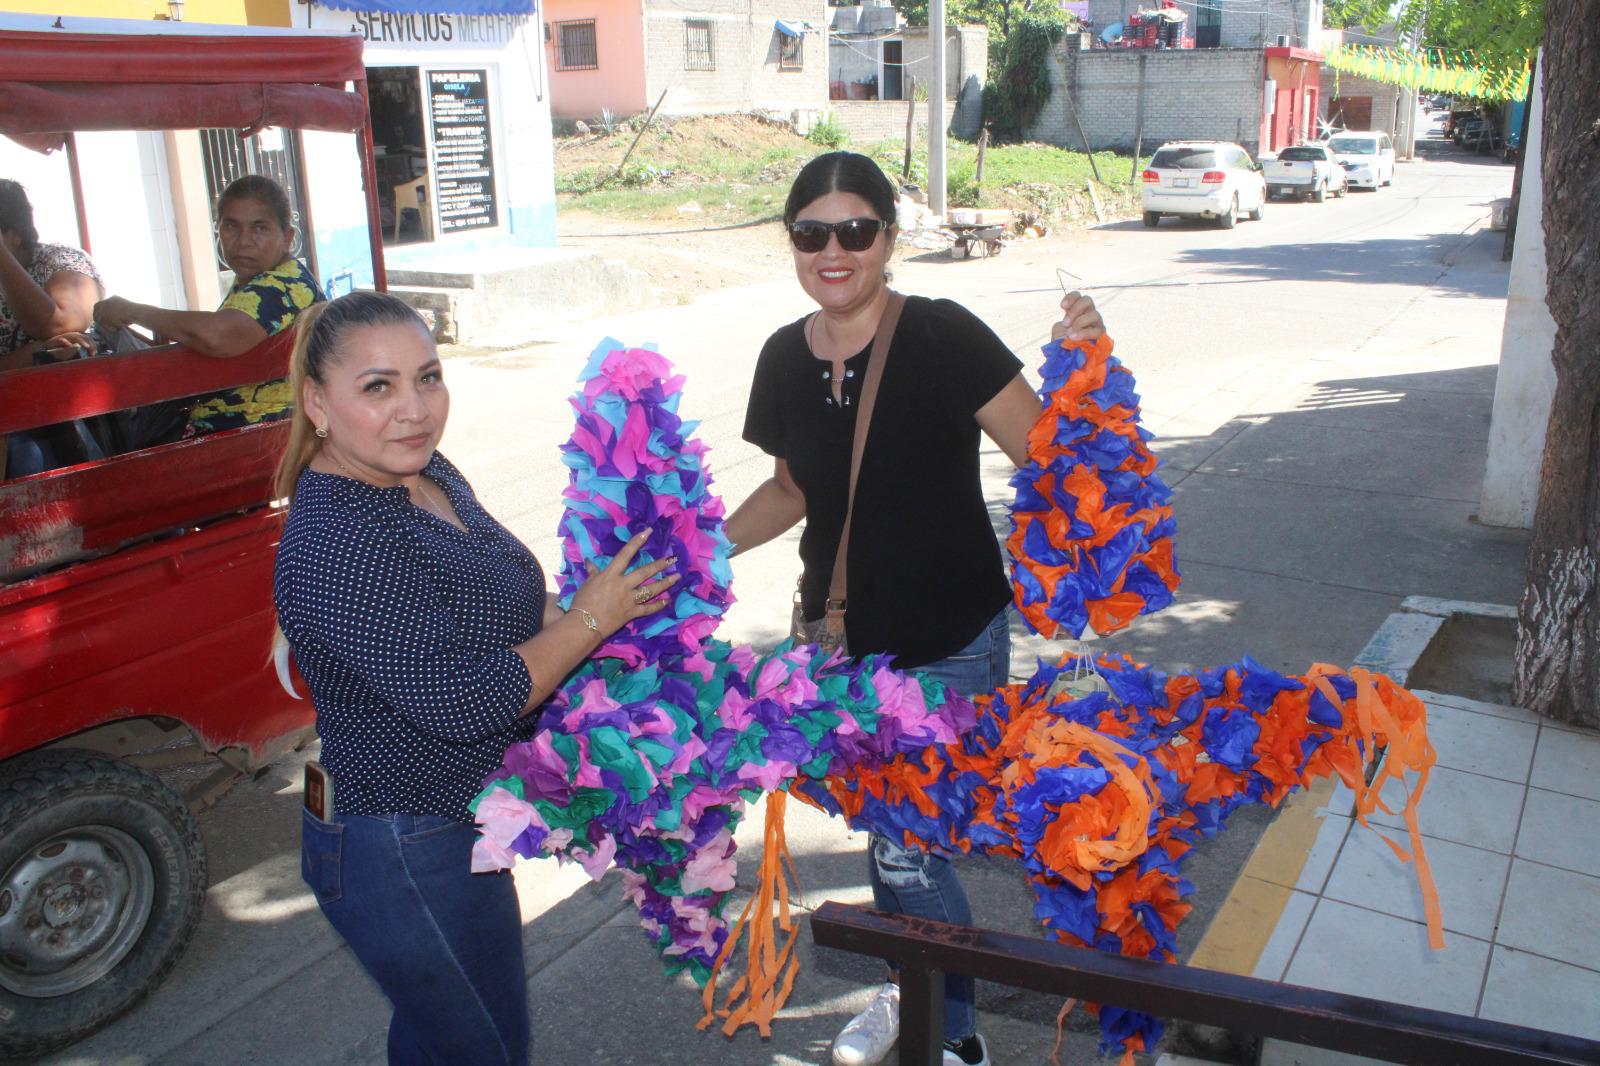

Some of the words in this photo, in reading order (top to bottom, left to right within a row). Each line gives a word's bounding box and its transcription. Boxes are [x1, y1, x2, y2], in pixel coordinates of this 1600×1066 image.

[355, 11, 453, 42] SERVICIOS
[431, 73, 481, 83] PAPELERIA
[149, 826, 180, 911] GENERAL
